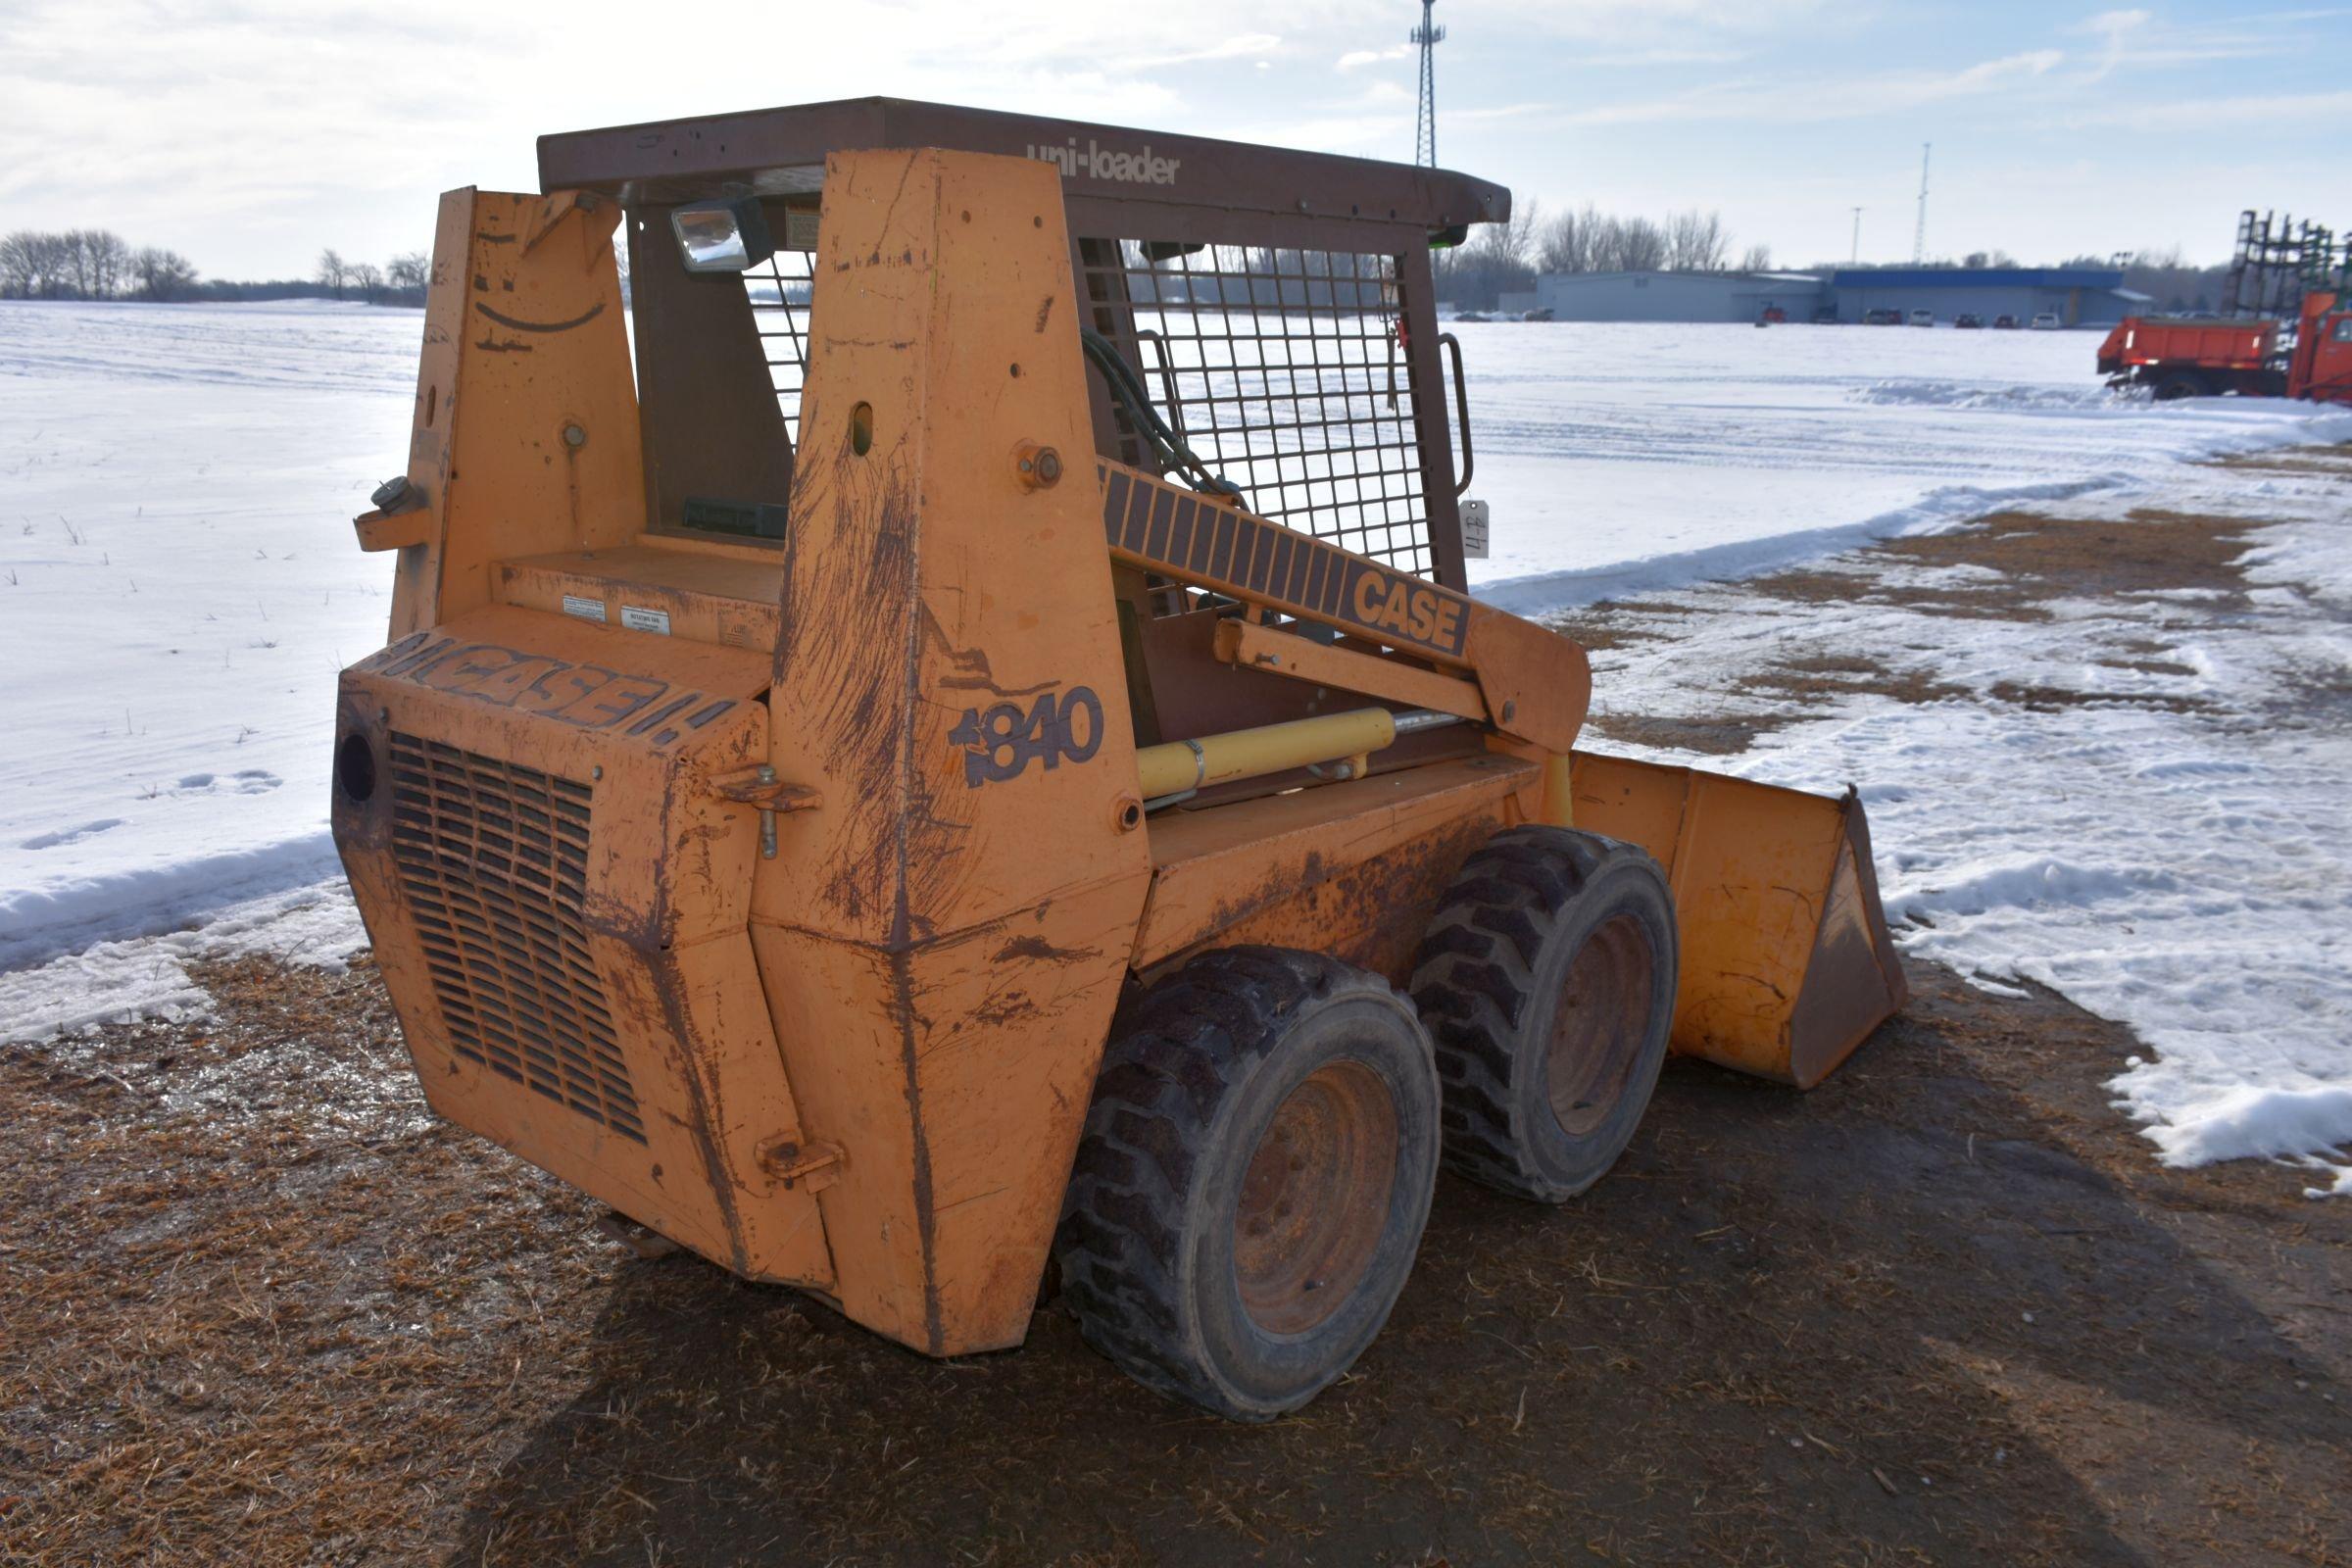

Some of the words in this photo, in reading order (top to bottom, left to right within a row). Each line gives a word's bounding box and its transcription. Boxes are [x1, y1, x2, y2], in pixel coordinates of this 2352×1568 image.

[1354, 570, 1461, 650] CASE
[413, 646, 668, 728] CASE
[948, 686, 1104, 789] 1840
